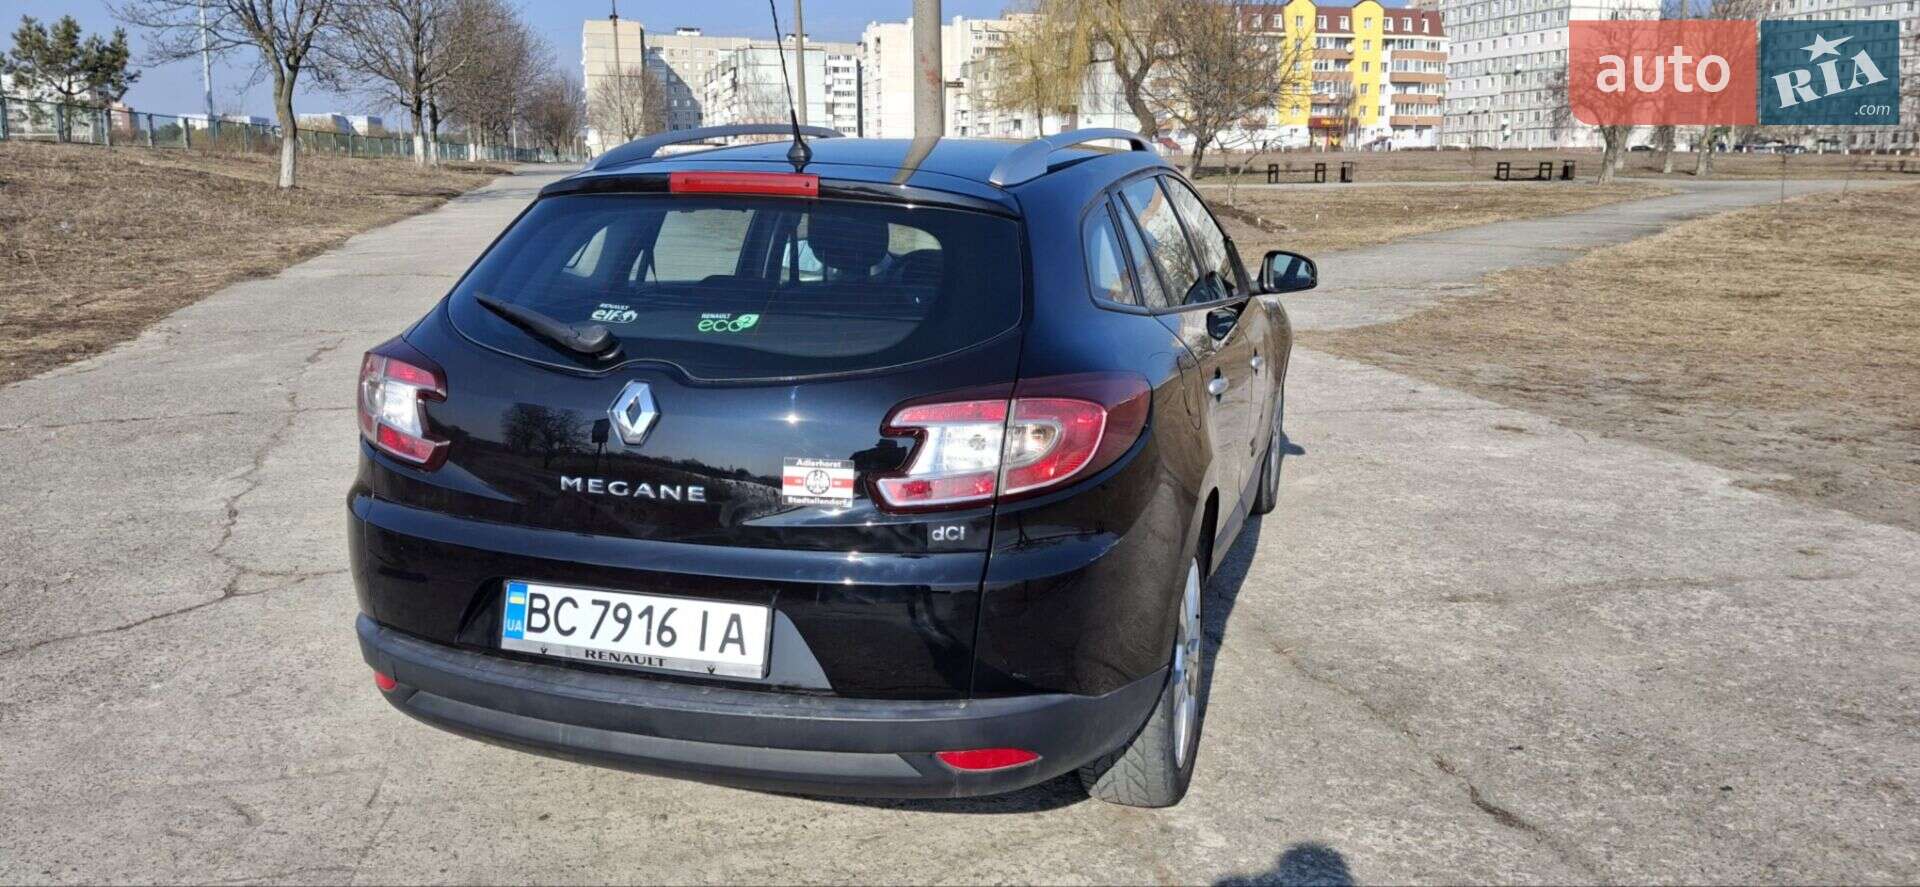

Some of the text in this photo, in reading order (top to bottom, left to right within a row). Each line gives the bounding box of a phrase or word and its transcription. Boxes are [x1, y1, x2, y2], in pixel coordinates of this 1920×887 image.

[796, 458, 841, 468] Adlerhorst
[560, 475, 706, 503] MEGANE
[506, 619, 522, 632] UA
[526, 592, 746, 656] BC 7916 IA
[584, 649, 667, 668] RENAULT
